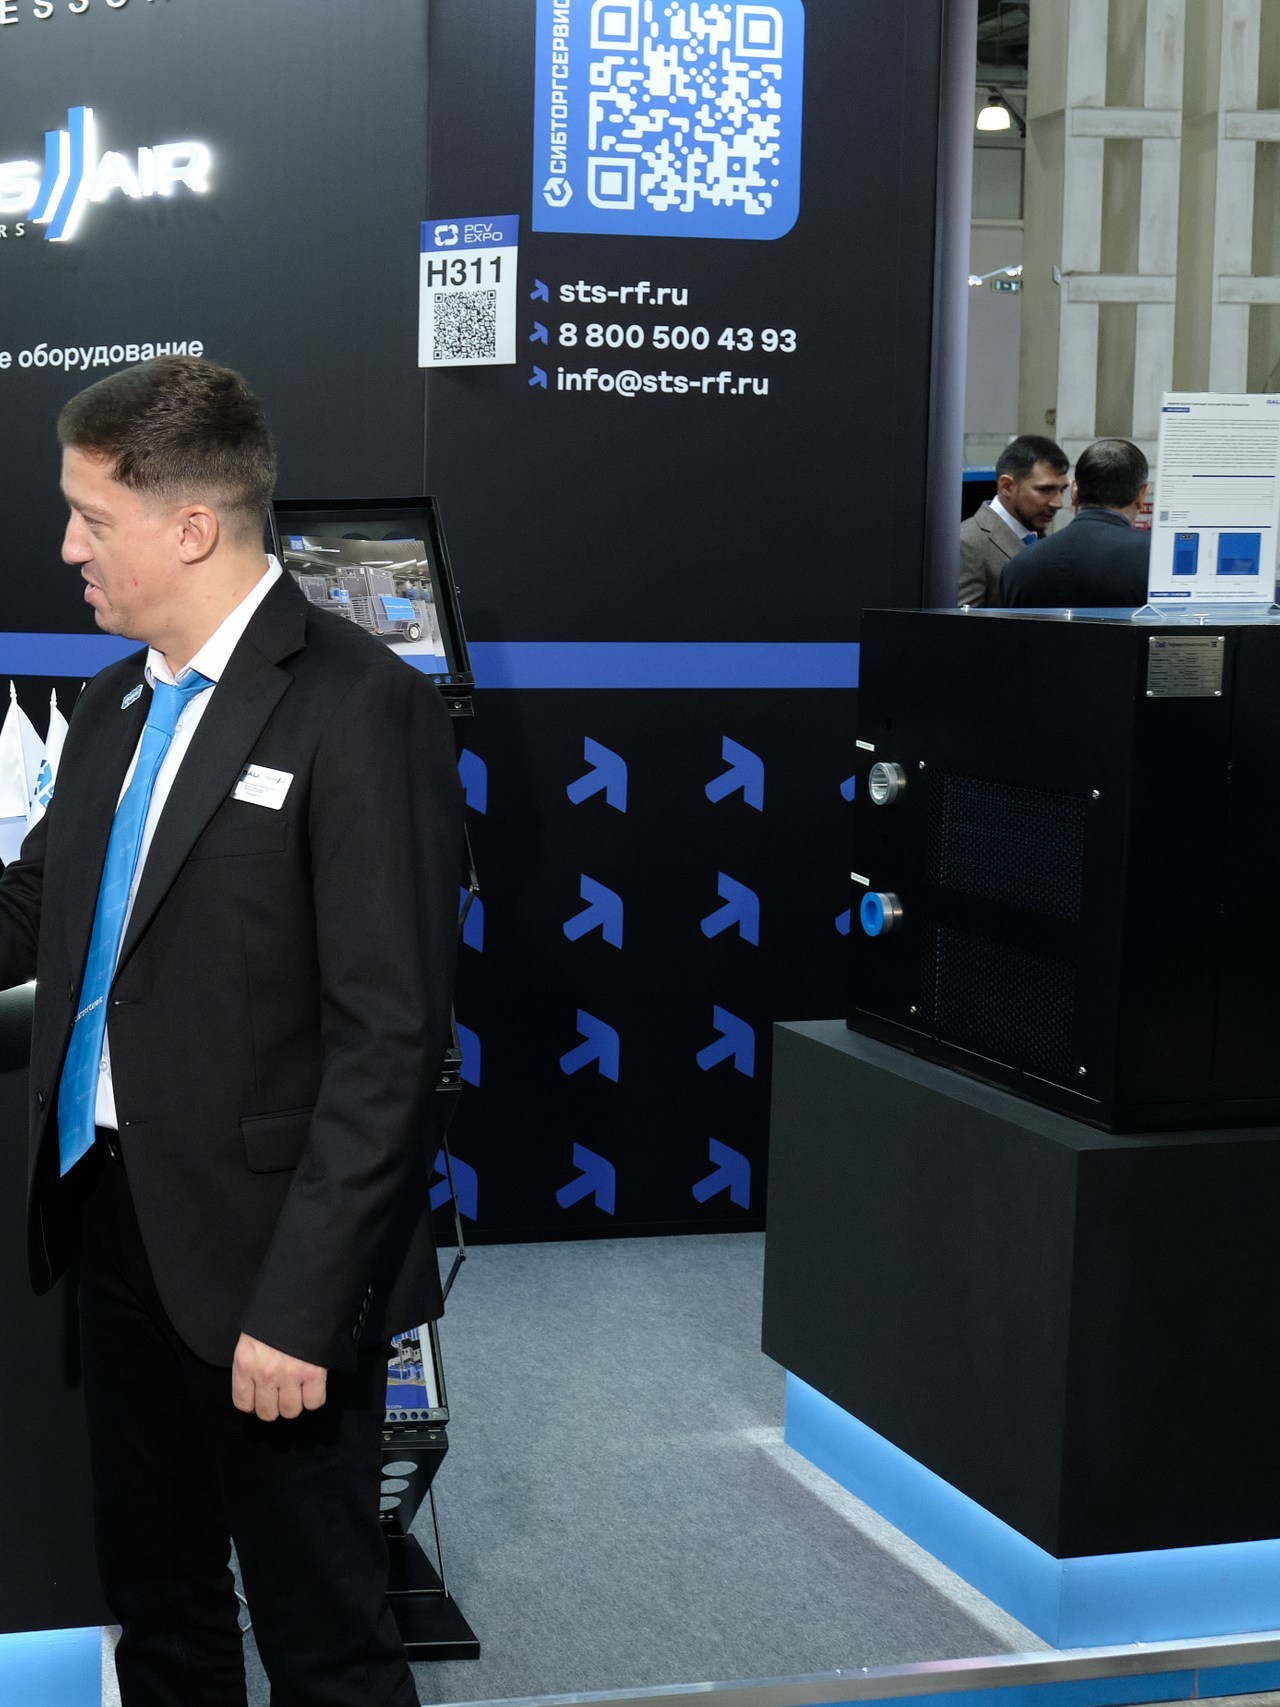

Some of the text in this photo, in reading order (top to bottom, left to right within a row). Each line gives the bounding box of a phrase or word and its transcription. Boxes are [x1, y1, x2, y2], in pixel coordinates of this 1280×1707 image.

[549, 0, 570, 174] СИБТОРГСЕРВИС
[464, 223, 493, 234] PCV
[464, 232, 503, 243] EXPO
[427, 256, 501, 287] H311
[559, 281, 688, 306] sts-rf.ru
[558, 323, 797, 353] 8 800 500 43 93
[18, 339, 204, 371] оборудование
[556, 367, 769, 397] info@sts-rf.ru
